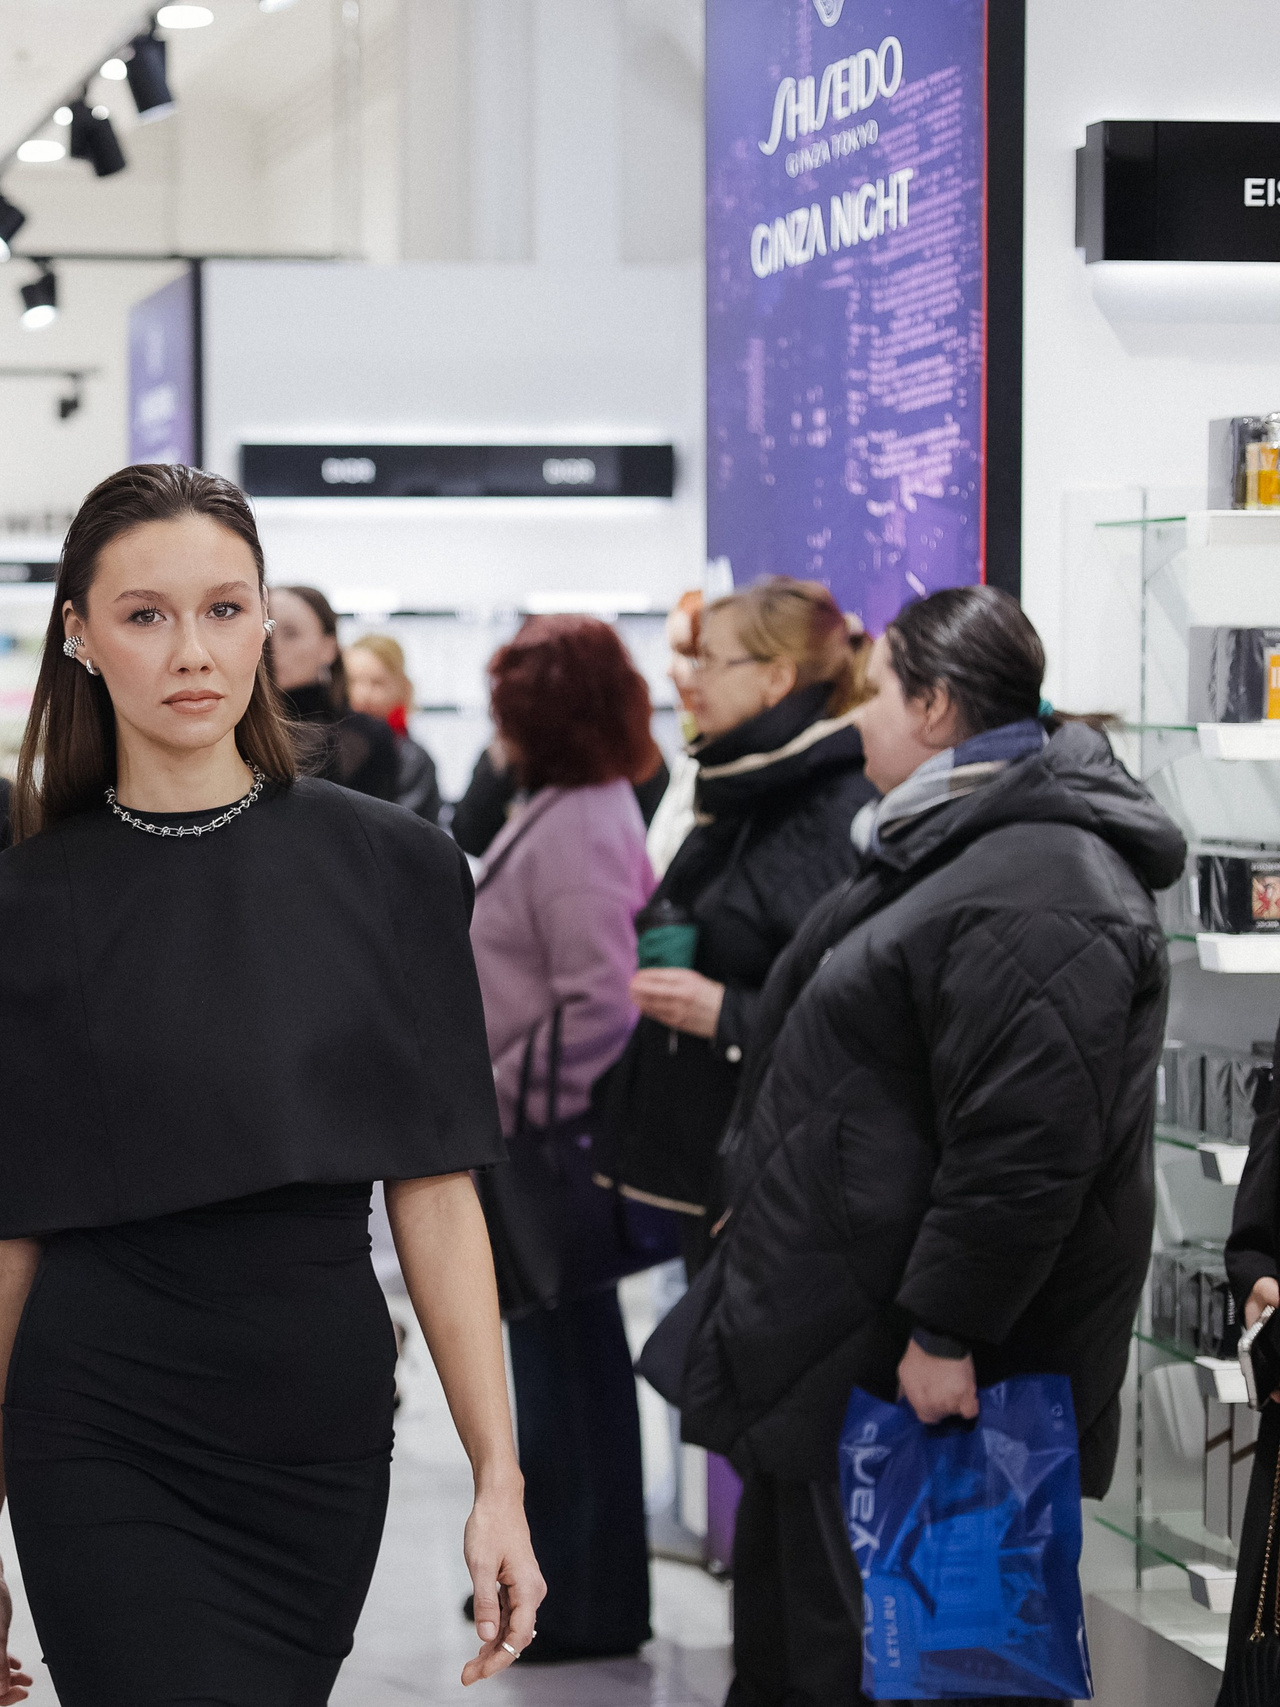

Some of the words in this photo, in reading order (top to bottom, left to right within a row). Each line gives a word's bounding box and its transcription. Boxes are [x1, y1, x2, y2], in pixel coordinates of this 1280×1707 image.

[758, 36, 903, 155] SHISEIDO
[785, 139, 830, 178] GINZA
[831, 119, 879, 159] TOKYO
[751, 203, 827, 278] GINZA
[830, 167, 913, 251] NIGHT
[1244, 177, 1280, 207] EI
